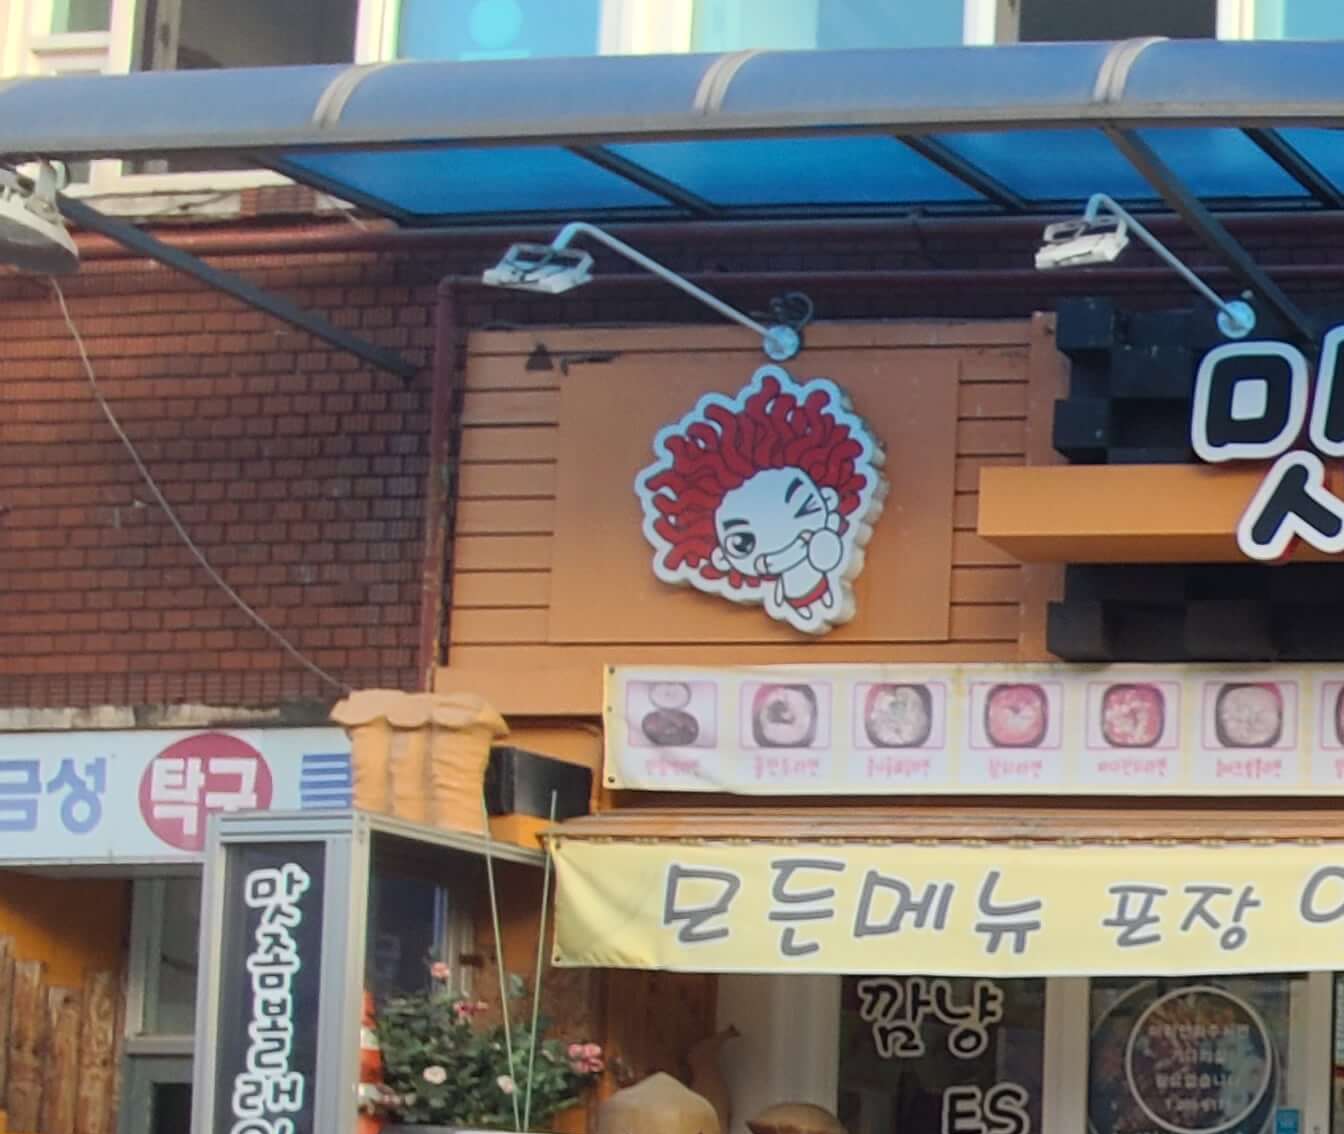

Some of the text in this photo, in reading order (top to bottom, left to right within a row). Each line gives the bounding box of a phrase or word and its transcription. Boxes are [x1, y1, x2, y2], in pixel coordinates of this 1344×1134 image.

[662, 858, 1043, 958] 모든메뉴
[1102, 882, 1262, 951] 포장
[858, 979, 1003, 1058] 깜냥
